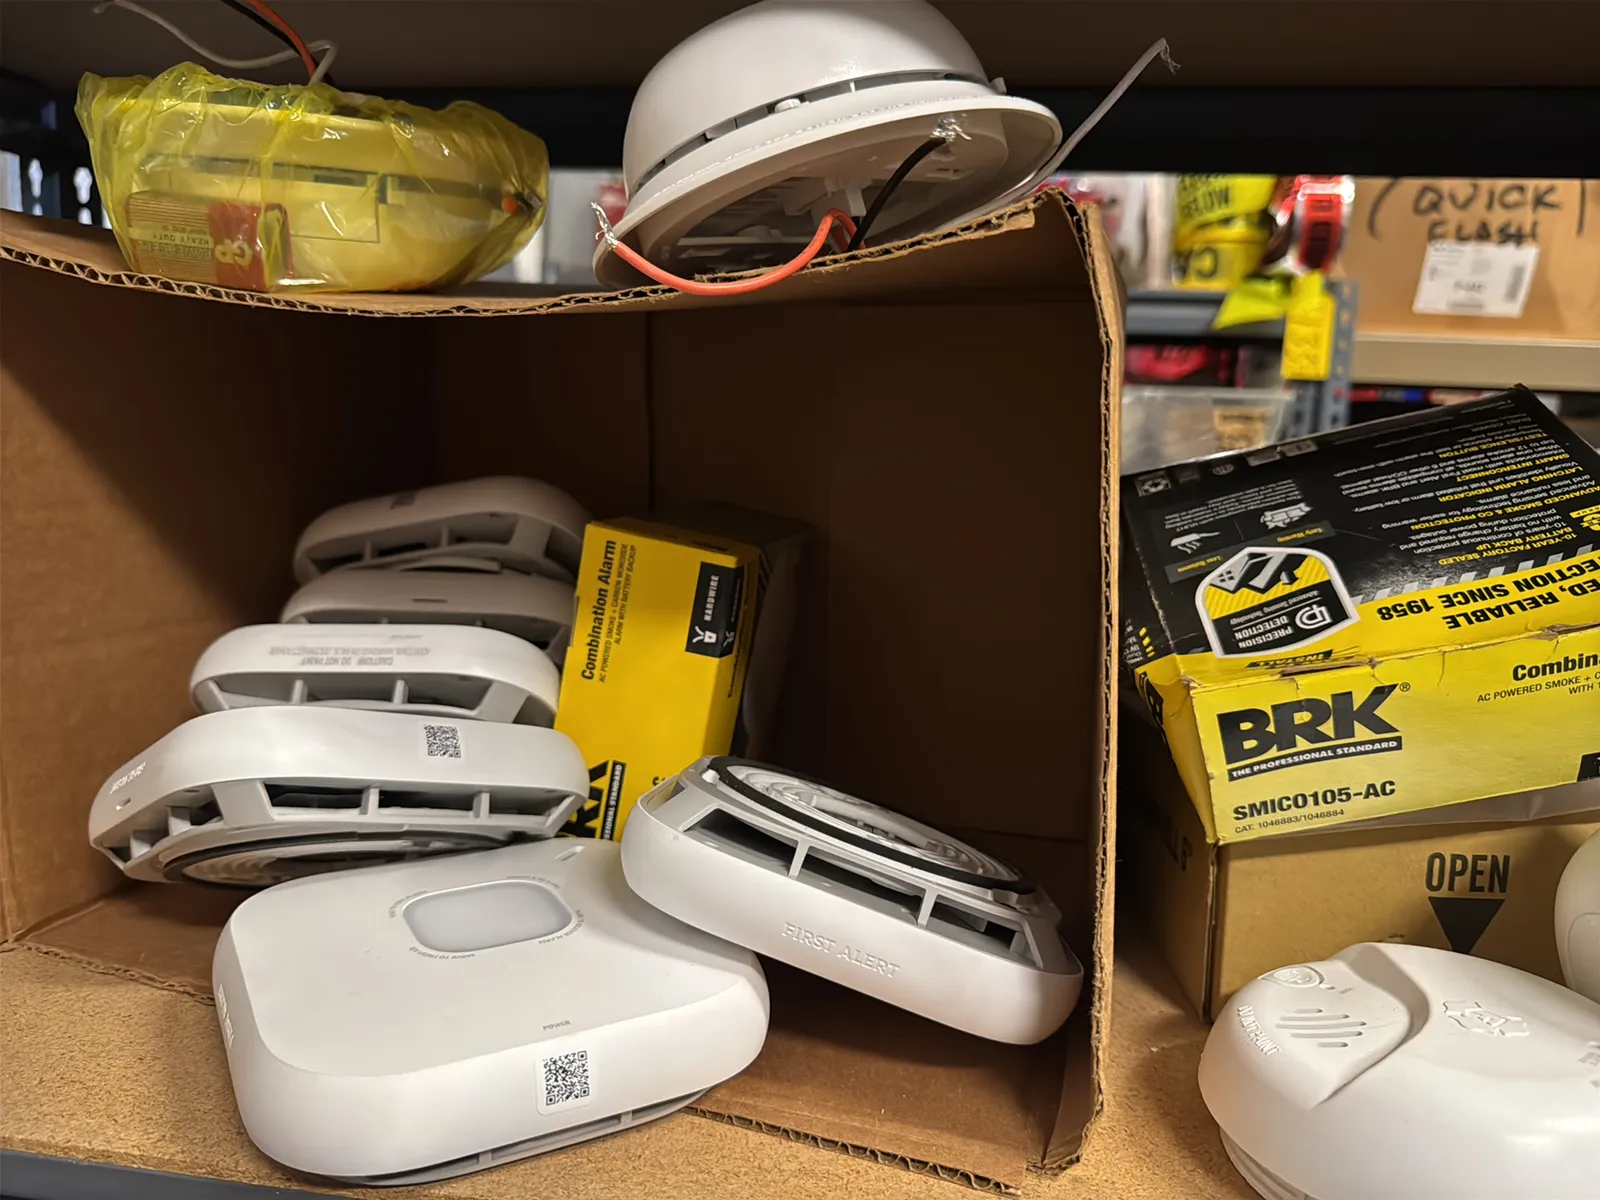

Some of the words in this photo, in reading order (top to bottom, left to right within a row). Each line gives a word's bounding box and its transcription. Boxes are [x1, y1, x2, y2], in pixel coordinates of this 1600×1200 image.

[1412, 183, 1560, 216] QUICK
[214, 240, 252, 266] GP
[1532, 453, 1571, 464] SMART
[1542, 460, 1578, 471] Visually
[1453, 461, 1534, 481] INTERCONNECT
[1529, 465, 1585, 481] LATCHING
[1571, 474, 1593, 482] and
[1491, 478, 1531, 490] ALARM
[1508, 484, 1552, 497] nuisance
[1548, 479, 1596, 495] Advanced
[1551, 479, 1572, 487] less
[1437, 486, 1493, 502] INDICATOR
[1510, 491, 1549, 503] sensing
[1543, 485, 1600, 504] ADVANCED
[1459, 498, 1511, 514] technology
[1503, 500, 1543, 512] SMOKE
[1409, 512, 1476, 531] PROTECTION
[1476, 510, 1494, 518] CO
[1508, 508, 1557, 522] protection
[1540, 514, 1562, 522] with
[1448, 523, 1478, 533] power
[1477, 517, 1509, 528] during
[1492, 521, 1526, 533] battery
[1523, 520, 1567, 533] 10-years
[1417, 533, 1457, 546] required
[1456, 527, 1492, 539] change
[1460, 530, 1512, 546] continuous
[1522, 526, 1573, 541] BATTERY
[1530, 532, 1578, 547] 10-YEAR
[1398, 542, 1418, 550] and
[1411, 539, 1460, 554] protection
[1480, 542, 1531, 557] FACTORY
[1491, 537, 1523, 548] BACK
[1437, 551, 1480, 565] SEALED
[704, 573, 718, 621] HARDWIRE
[1287, 589, 1318, 604] Advanced
[1436, 580, 1510, 610] SINCE
[583, 587, 608, 680] Combination
[598, 538, 616, 585] Alarm
[1262, 599, 1288, 613] Sensing
[1375, 595, 1434, 622] 1958
[1440, 590, 1560, 630] RELIABLE
[1228, 608, 1263, 626] Technology
[1233, 614, 1288, 639] DETECTION
[1237, 624, 1292, 648] PRECISION
[1513, 653, 1600, 681] Combin
[1477, 692, 1491, 702] AC
[1494, 683, 1542, 699] POWERED
[1545, 675, 1581, 689] SMOKE
[1569, 683, 1594, 695] WITH
[1216, 683, 1401, 765] BRK
[1231, 767, 1252, 778] THE
[1253, 748, 1334, 773] PROFESSIONAL
[1336, 740, 1398, 756] STANDARD
[609, 763, 623, 806] STANDARD
[1235, 825, 1255, 834] CAT.
[1258, 808, 1345, 829] 1046883/1046884
[1425, 852, 1510, 894] OPEN
[784, 921, 835, 954] FIRST
[837, 944, 899, 979] ALERT
[542, 1020, 571, 1031] POWER
